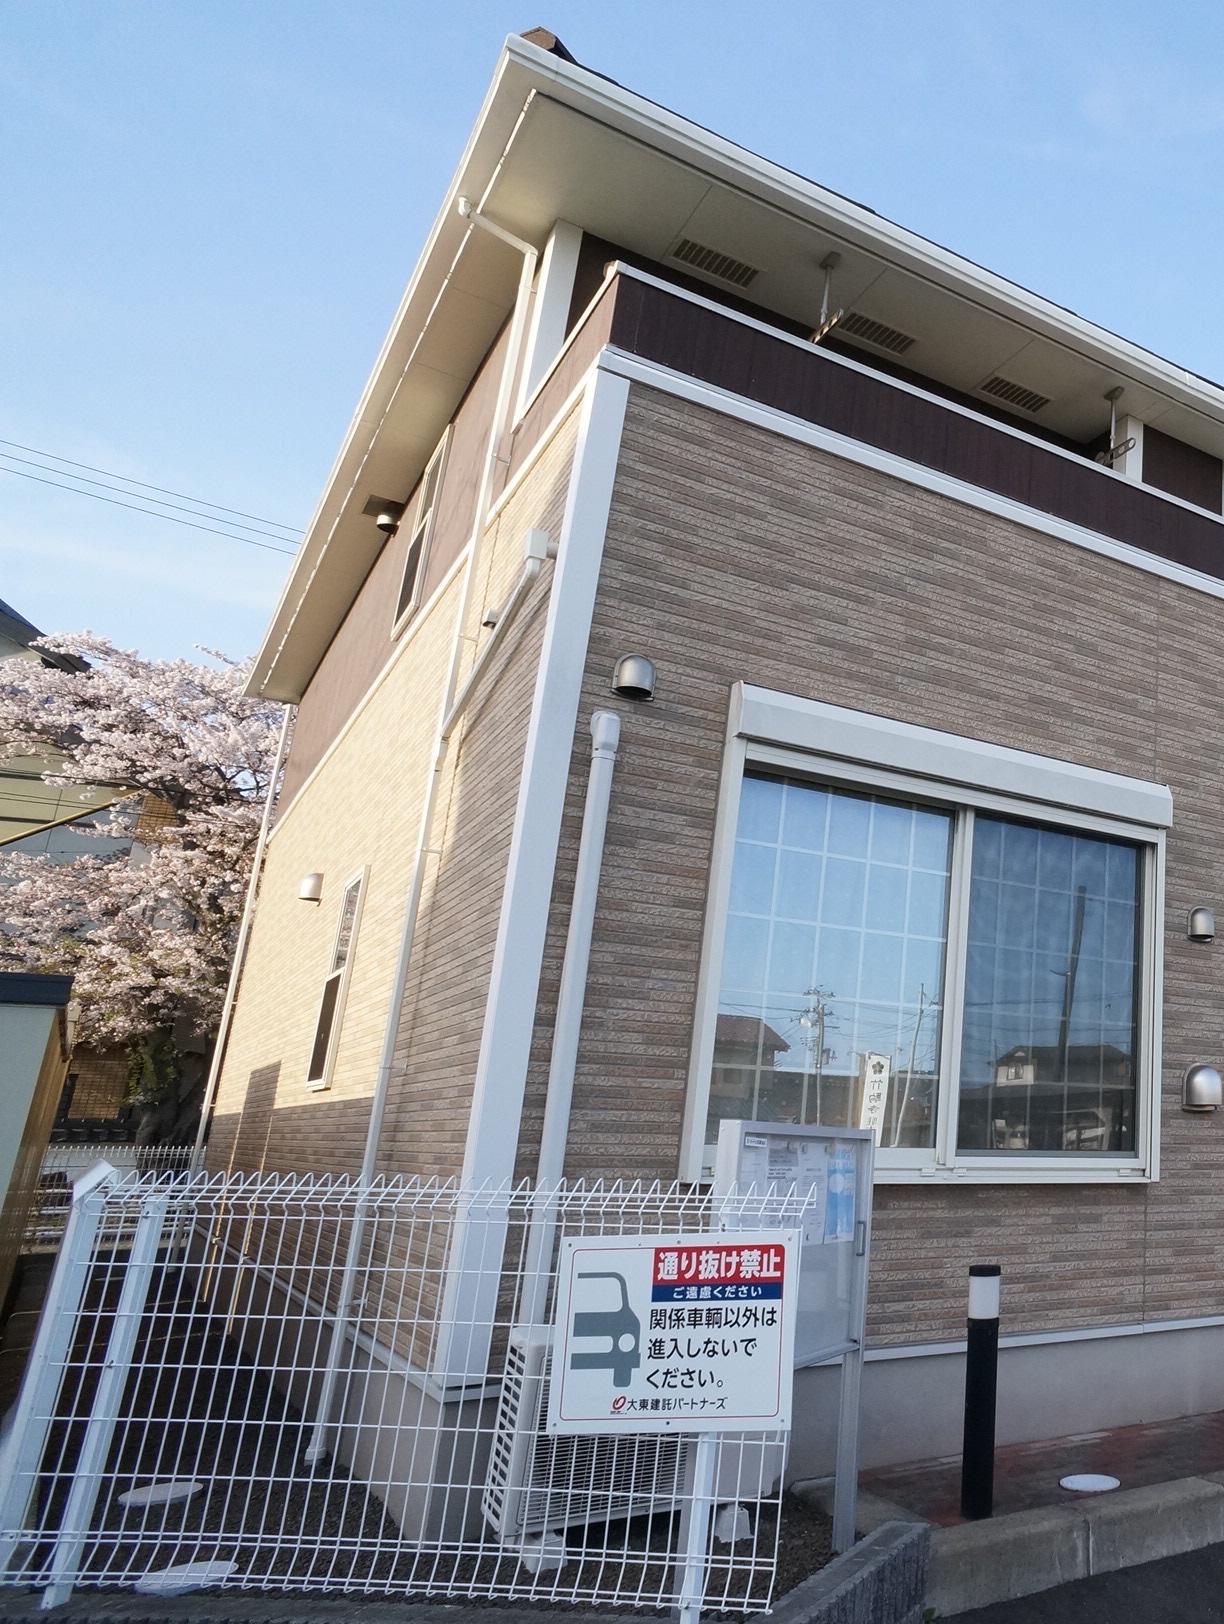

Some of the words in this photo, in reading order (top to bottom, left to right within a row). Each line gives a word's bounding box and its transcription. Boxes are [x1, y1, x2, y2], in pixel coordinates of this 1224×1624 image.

[658, 1249, 781, 1280] 通り抜け禁止
[673, 1285, 762, 1299] ご遠慮ください
[647, 1337, 757, 1360] 進入しないで
[646, 1367, 723, 1389] ください。
[627, 1397, 728, 1411] 大東建託パートナーズ
